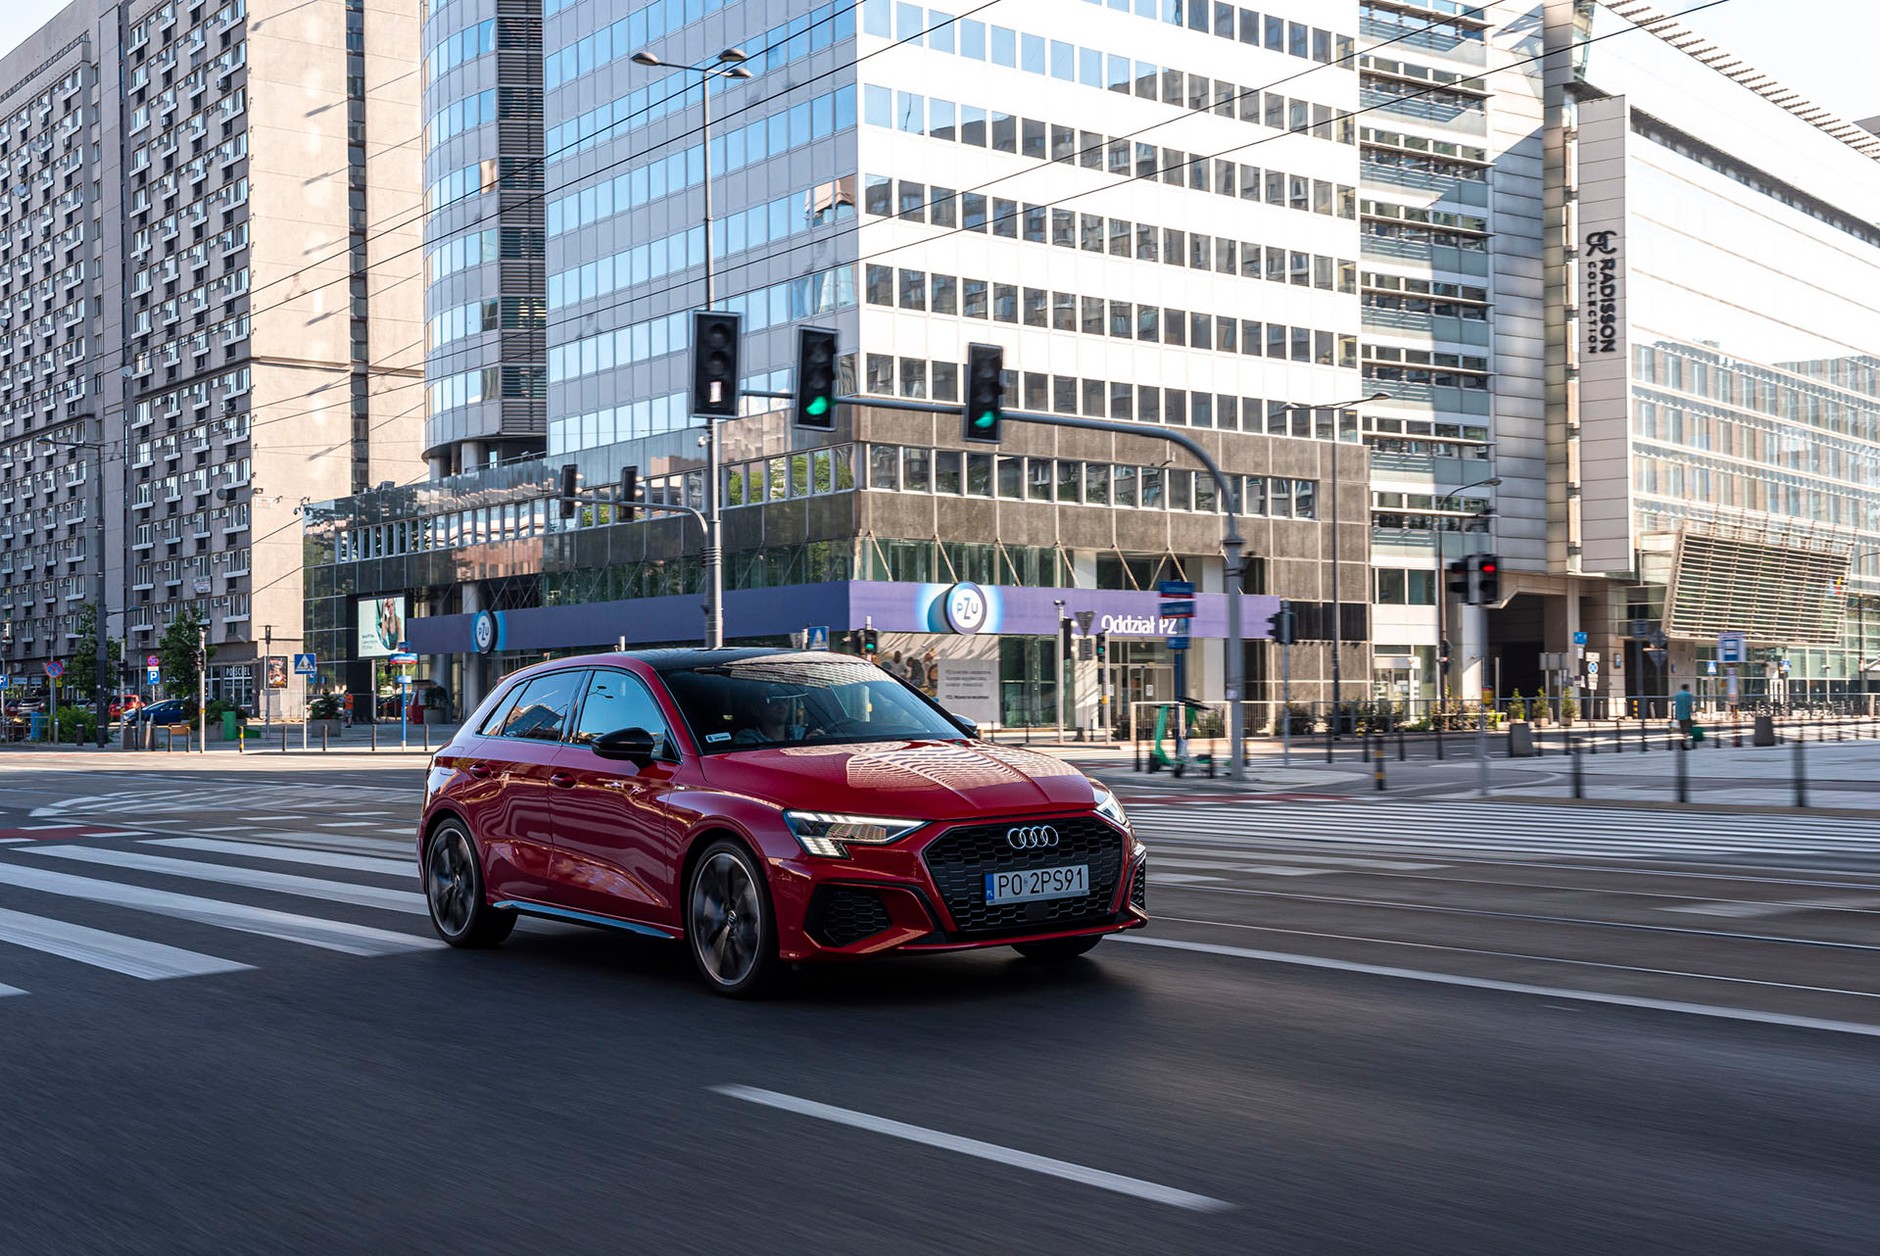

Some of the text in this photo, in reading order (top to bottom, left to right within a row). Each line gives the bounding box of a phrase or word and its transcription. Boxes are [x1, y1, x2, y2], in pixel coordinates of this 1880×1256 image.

[1587, 261, 1597, 354] COLLECTION
[1599, 258, 1617, 353] RADISSON
[956, 597, 979, 620] PZU
[478, 622, 490, 641] PZU
[1101, 615, 1178, 635] Oddział PZ
[150, 671, 157, 681] P
[998, 867, 1083, 897] PO 2PS91
